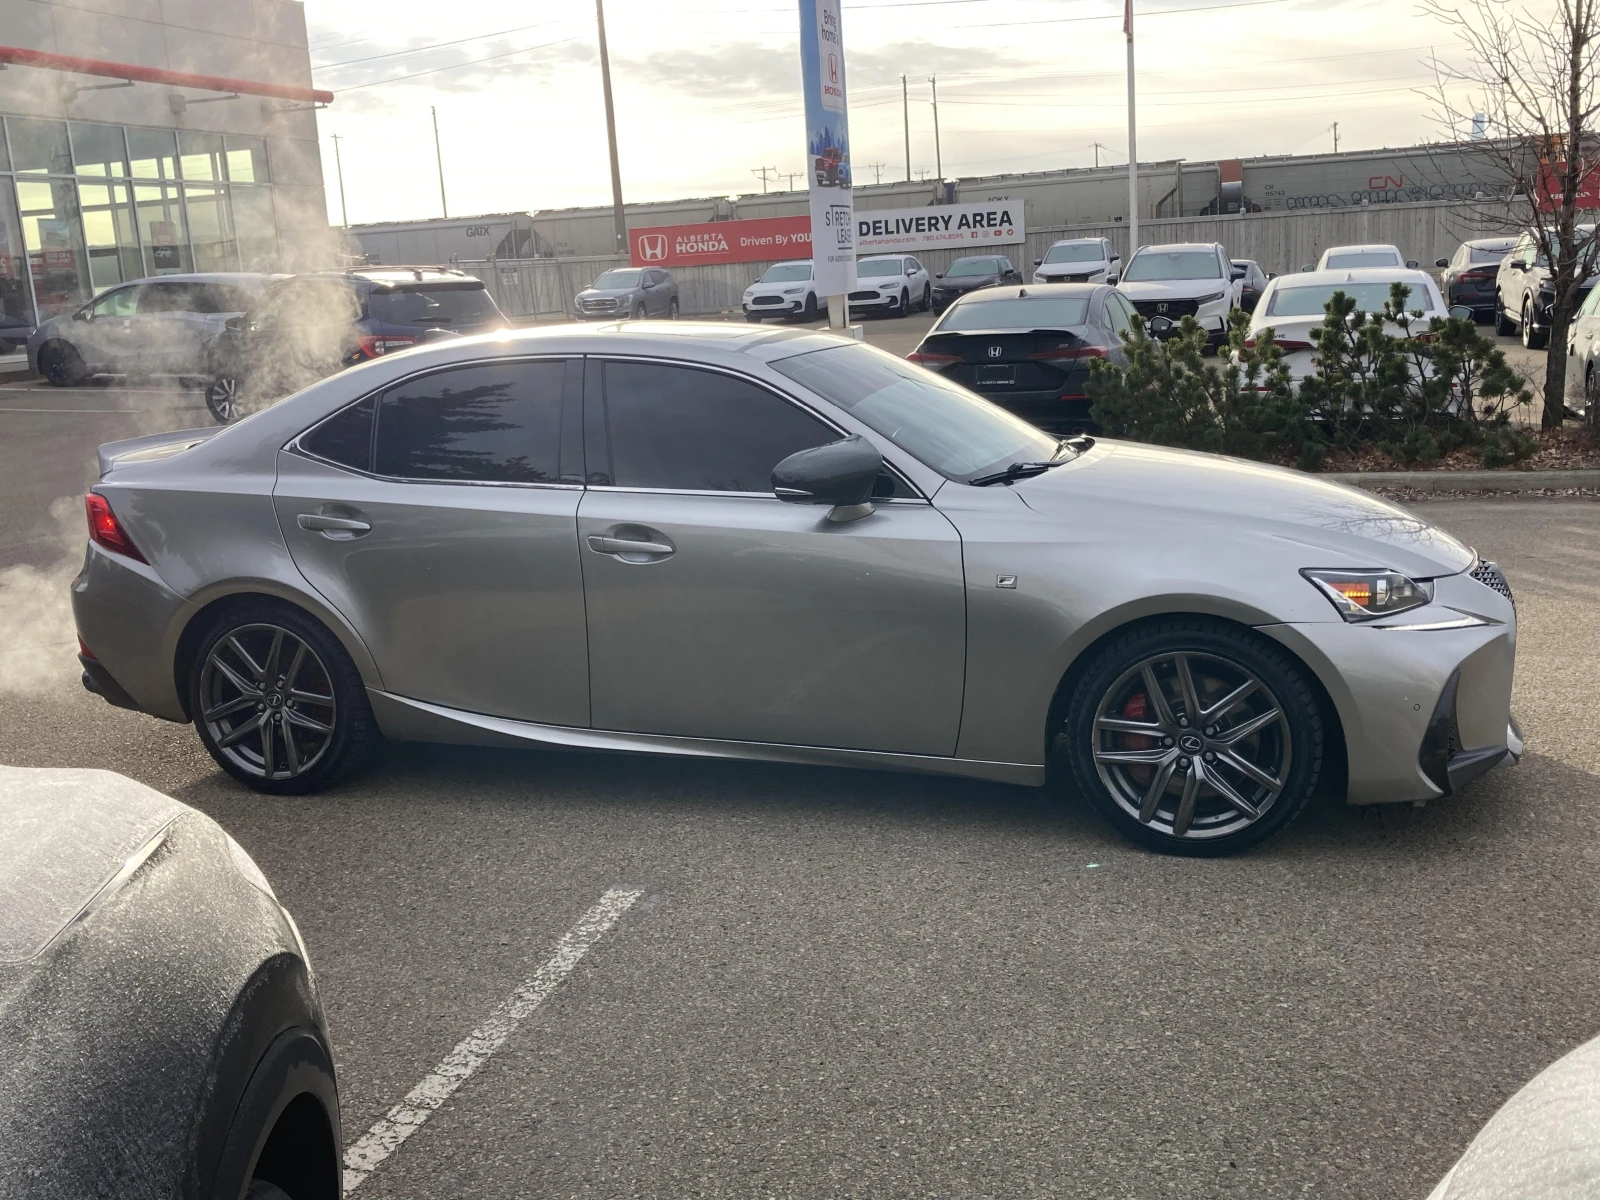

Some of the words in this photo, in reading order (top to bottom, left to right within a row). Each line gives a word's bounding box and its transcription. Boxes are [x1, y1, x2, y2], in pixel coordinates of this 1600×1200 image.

[1368, 174, 1404, 189] CN
[858, 214, 953, 237] DELIVERY
[957, 210, 1013, 230] AREA
[466, 226, 490, 237] GATX
[676, 233, 724, 243] ALBERTA
[740, 236, 773, 247] Driven
[775, 234, 788, 246] By
[790, 232, 813, 243] YOU
[859, 236, 916, 246] albertahonda.com
[922, 233, 964, 242] 780.474.8595
[675, 240, 729, 254] HONDA
